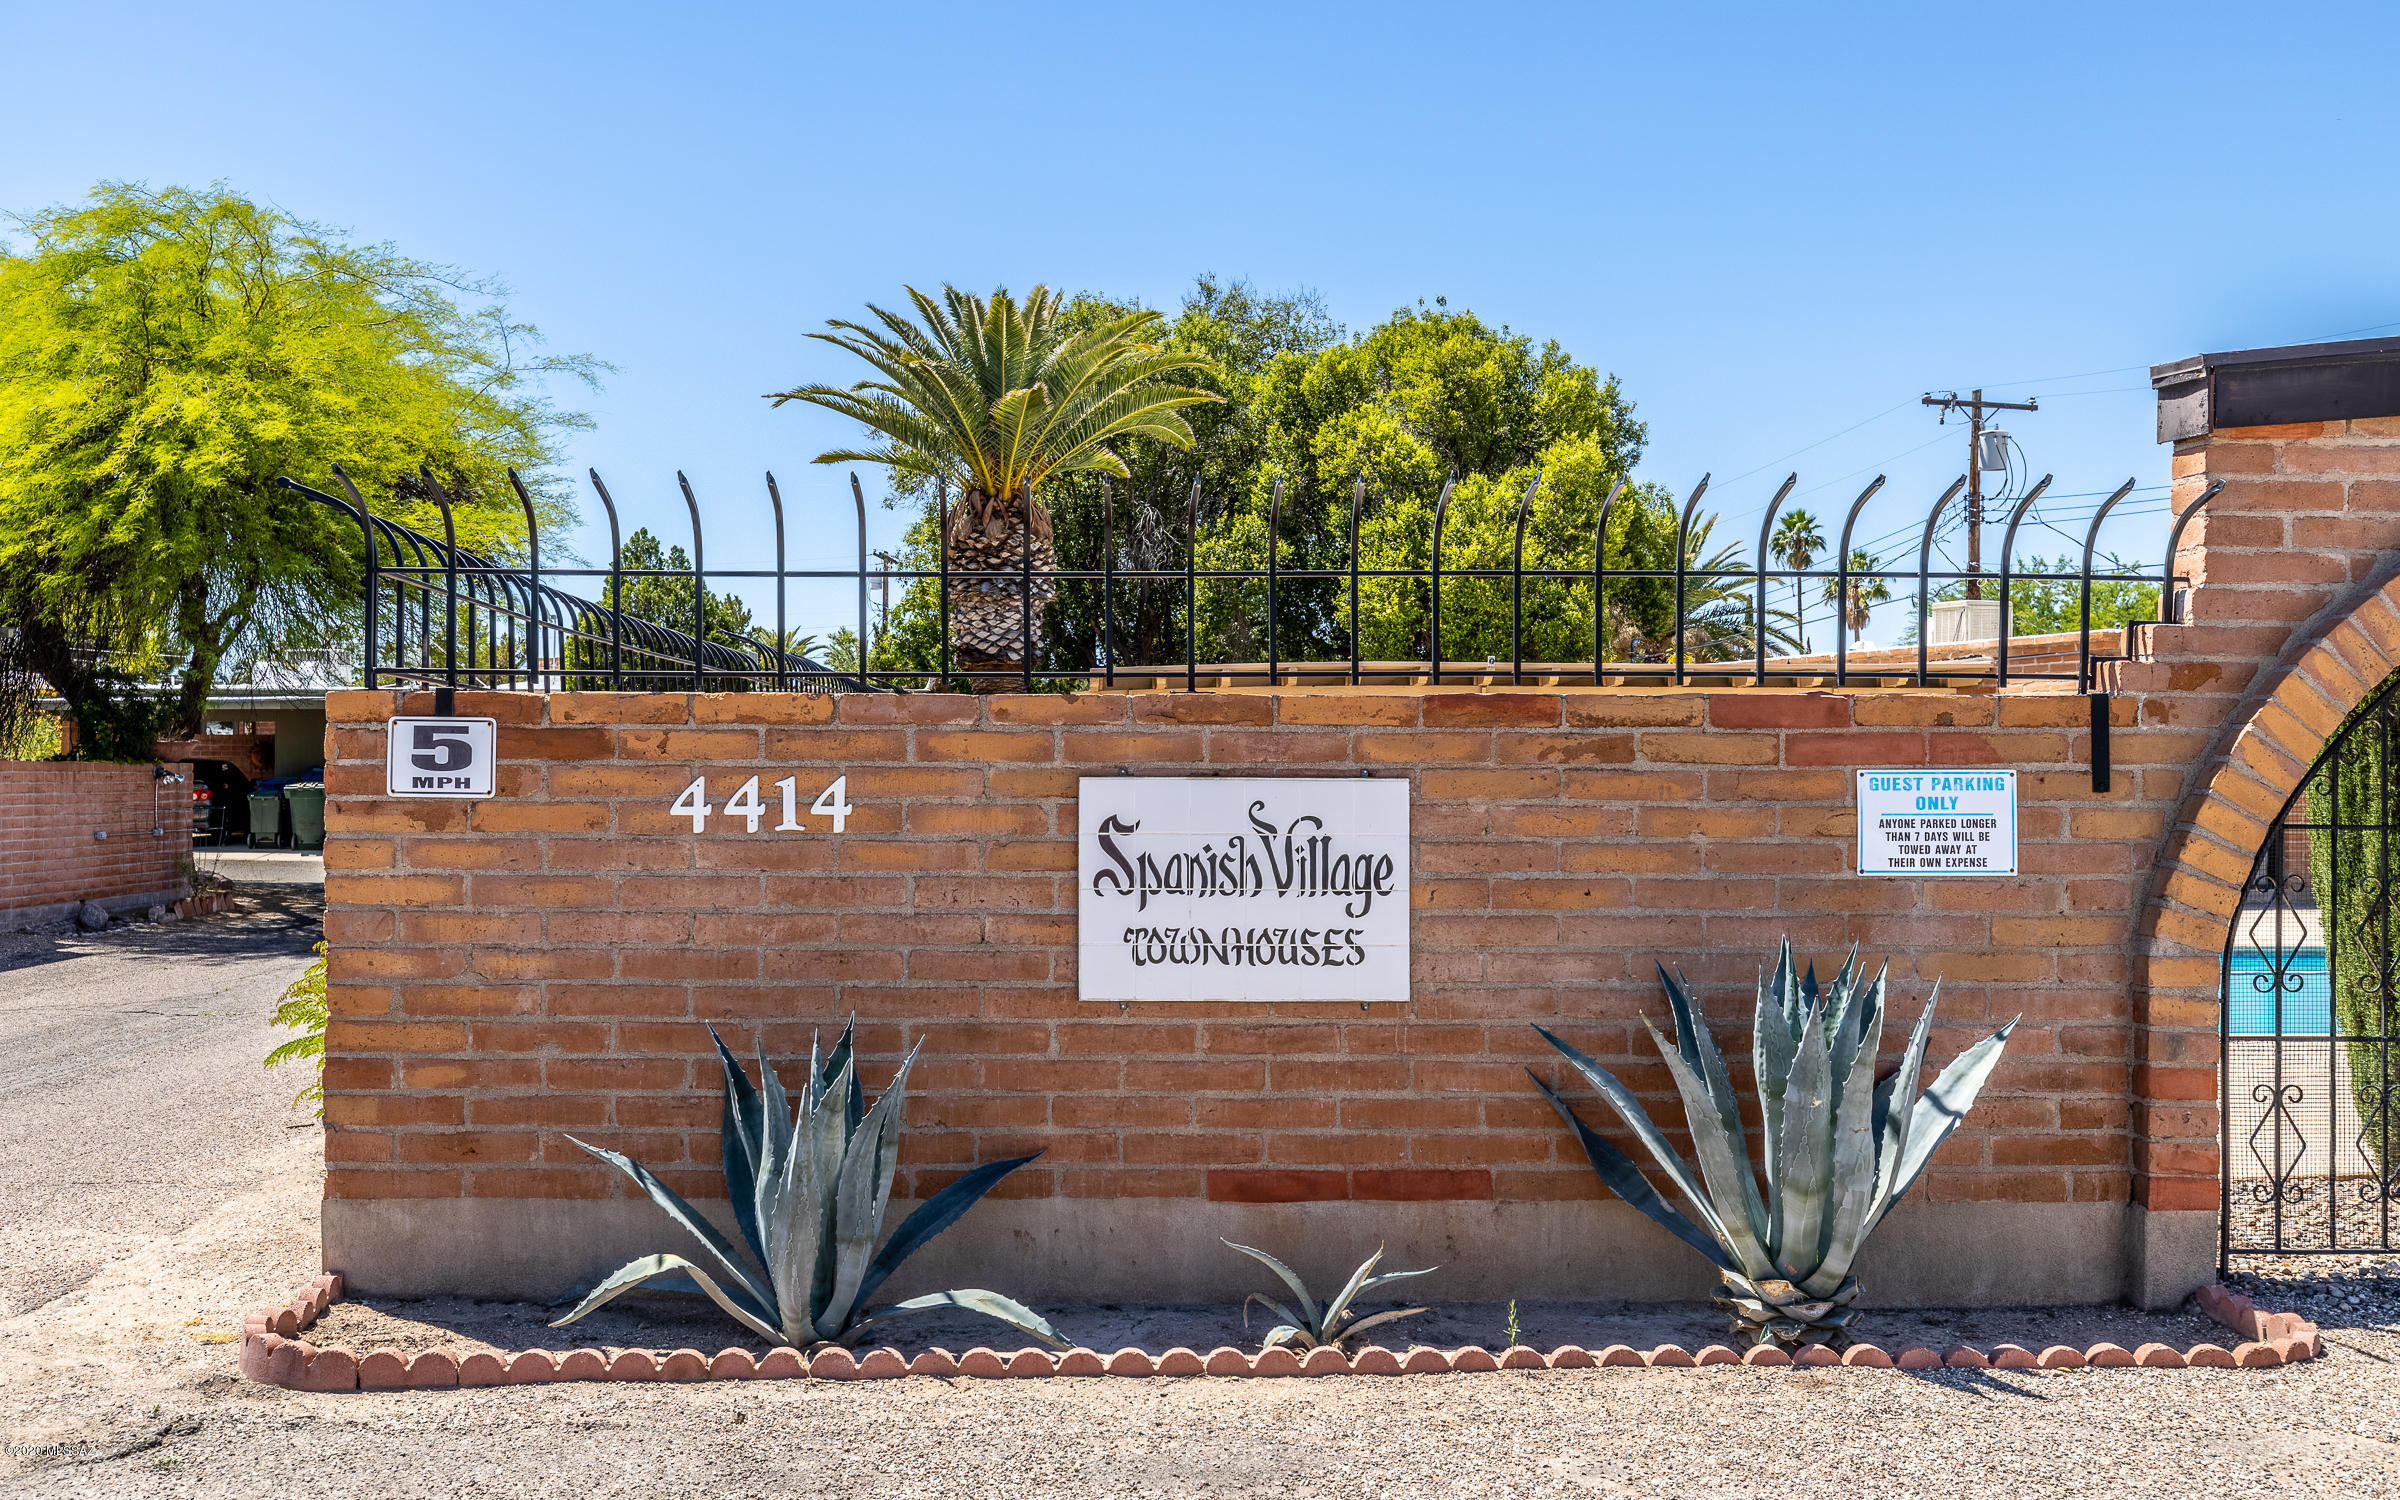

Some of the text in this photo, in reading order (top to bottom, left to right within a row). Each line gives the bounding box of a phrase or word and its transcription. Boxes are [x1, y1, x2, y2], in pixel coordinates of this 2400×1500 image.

[412, 725, 472, 772] 5
[412, 777, 471, 789] MPH
[1869, 777, 2005, 791] GUEST PARKING
[670, 775, 853, 834] 4414
[1916, 796, 1959, 811] ONLY
[1879, 819, 1997, 829] ANYONE PARKED LONGER
[1885, 832, 1990, 842] THAN 7 DAYS WILL BE
[1898, 845, 1978, 855] TOWED AWAY AT
[1093, 800, 1395, 918] Spanish Village
[1888, 858, 1988, 868] THEIR OWN EXPENSE
[1123, 927, 1366, 967] TOWNHOUSES
